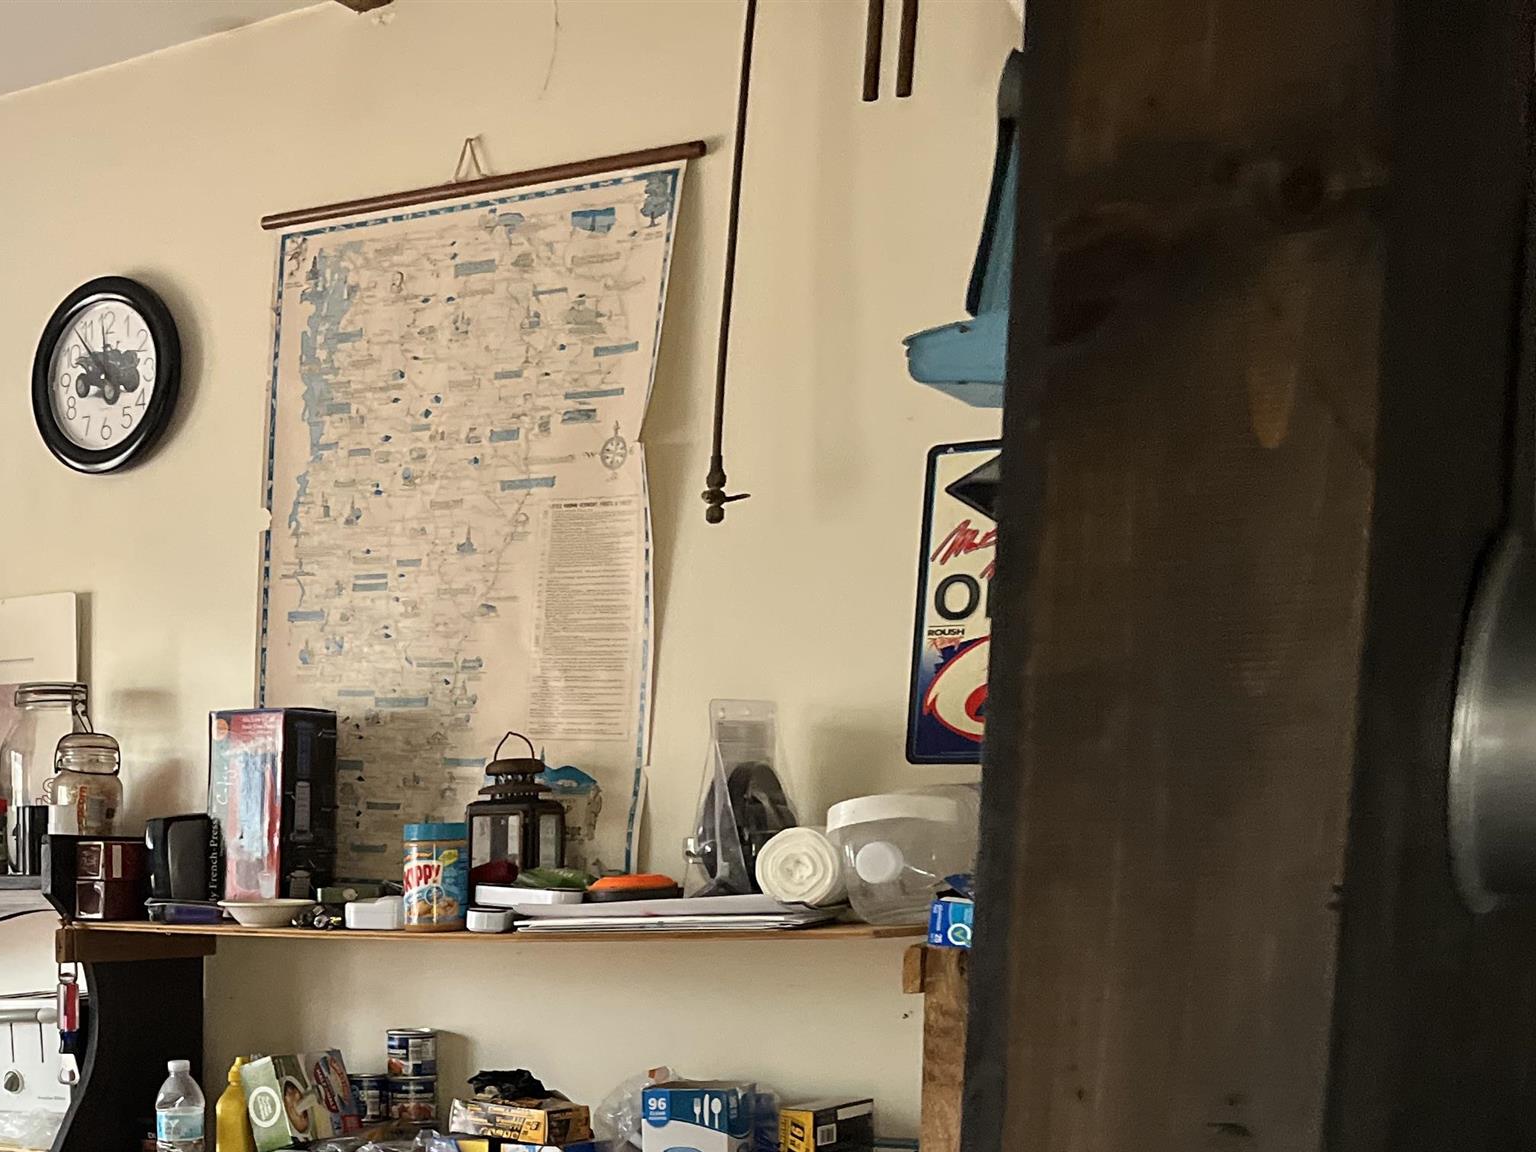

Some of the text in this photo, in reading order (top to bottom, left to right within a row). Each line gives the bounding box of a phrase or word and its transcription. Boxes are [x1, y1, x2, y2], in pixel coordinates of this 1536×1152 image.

[80, 319, 94, 343] 11
[98, 310, 116, 335] 12
[124, 314, 131, 337] 1
[136, 328, 148, 352] 2
[142, 356, 155, 383] 3
[60, 372, 72, 395] 9
[65, 395, 77, 421] 8
[135, 387, 146, 410] 4
[81, 415, 91, 437] 7
[100, 416, 113, 441] 6
[120, 405, 133, 430] 5
[933, 573, 981, 621] O
[927, 628, 965, 638] ROUSH
[648, 1097, 667, 1111] 96
